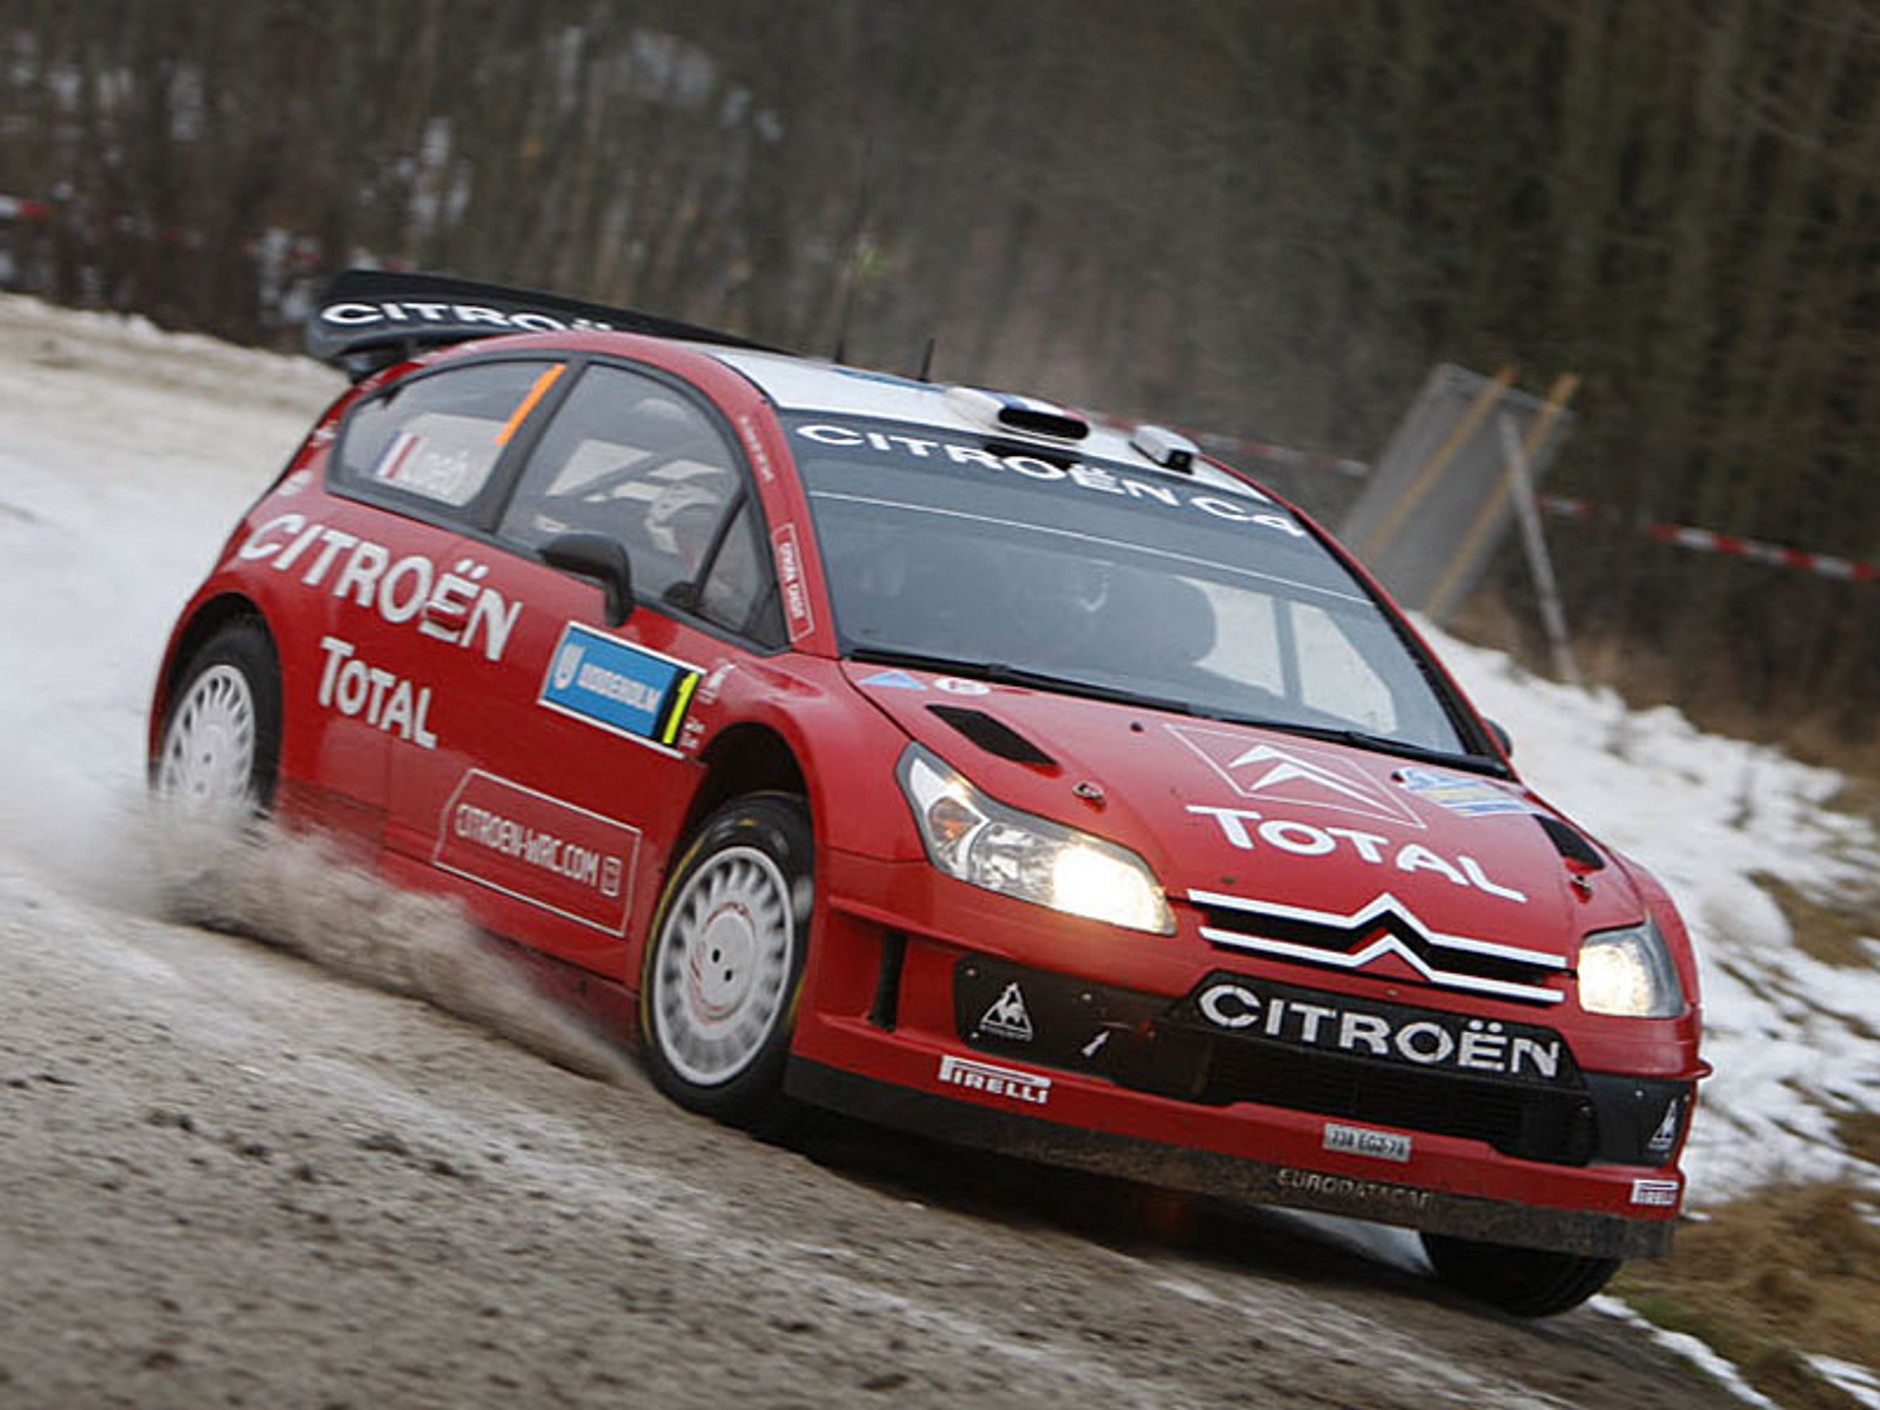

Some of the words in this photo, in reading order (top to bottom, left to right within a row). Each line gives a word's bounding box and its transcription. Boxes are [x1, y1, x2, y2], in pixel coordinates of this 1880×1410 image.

[797, 424, 1180, 506] CITROËN
[1191, 495, 1308, 538] C4
[238, 513, 523, 662] CITROËN
[317, 635, 438, 750] TOTAL
[662, 671, 699, 745] 1
[1185, 805, 1528, 903] TOTAL
[938, 1054, 1052, 1104] PIRELLI
[1199, 984, 1560, 1078] CITROËN
